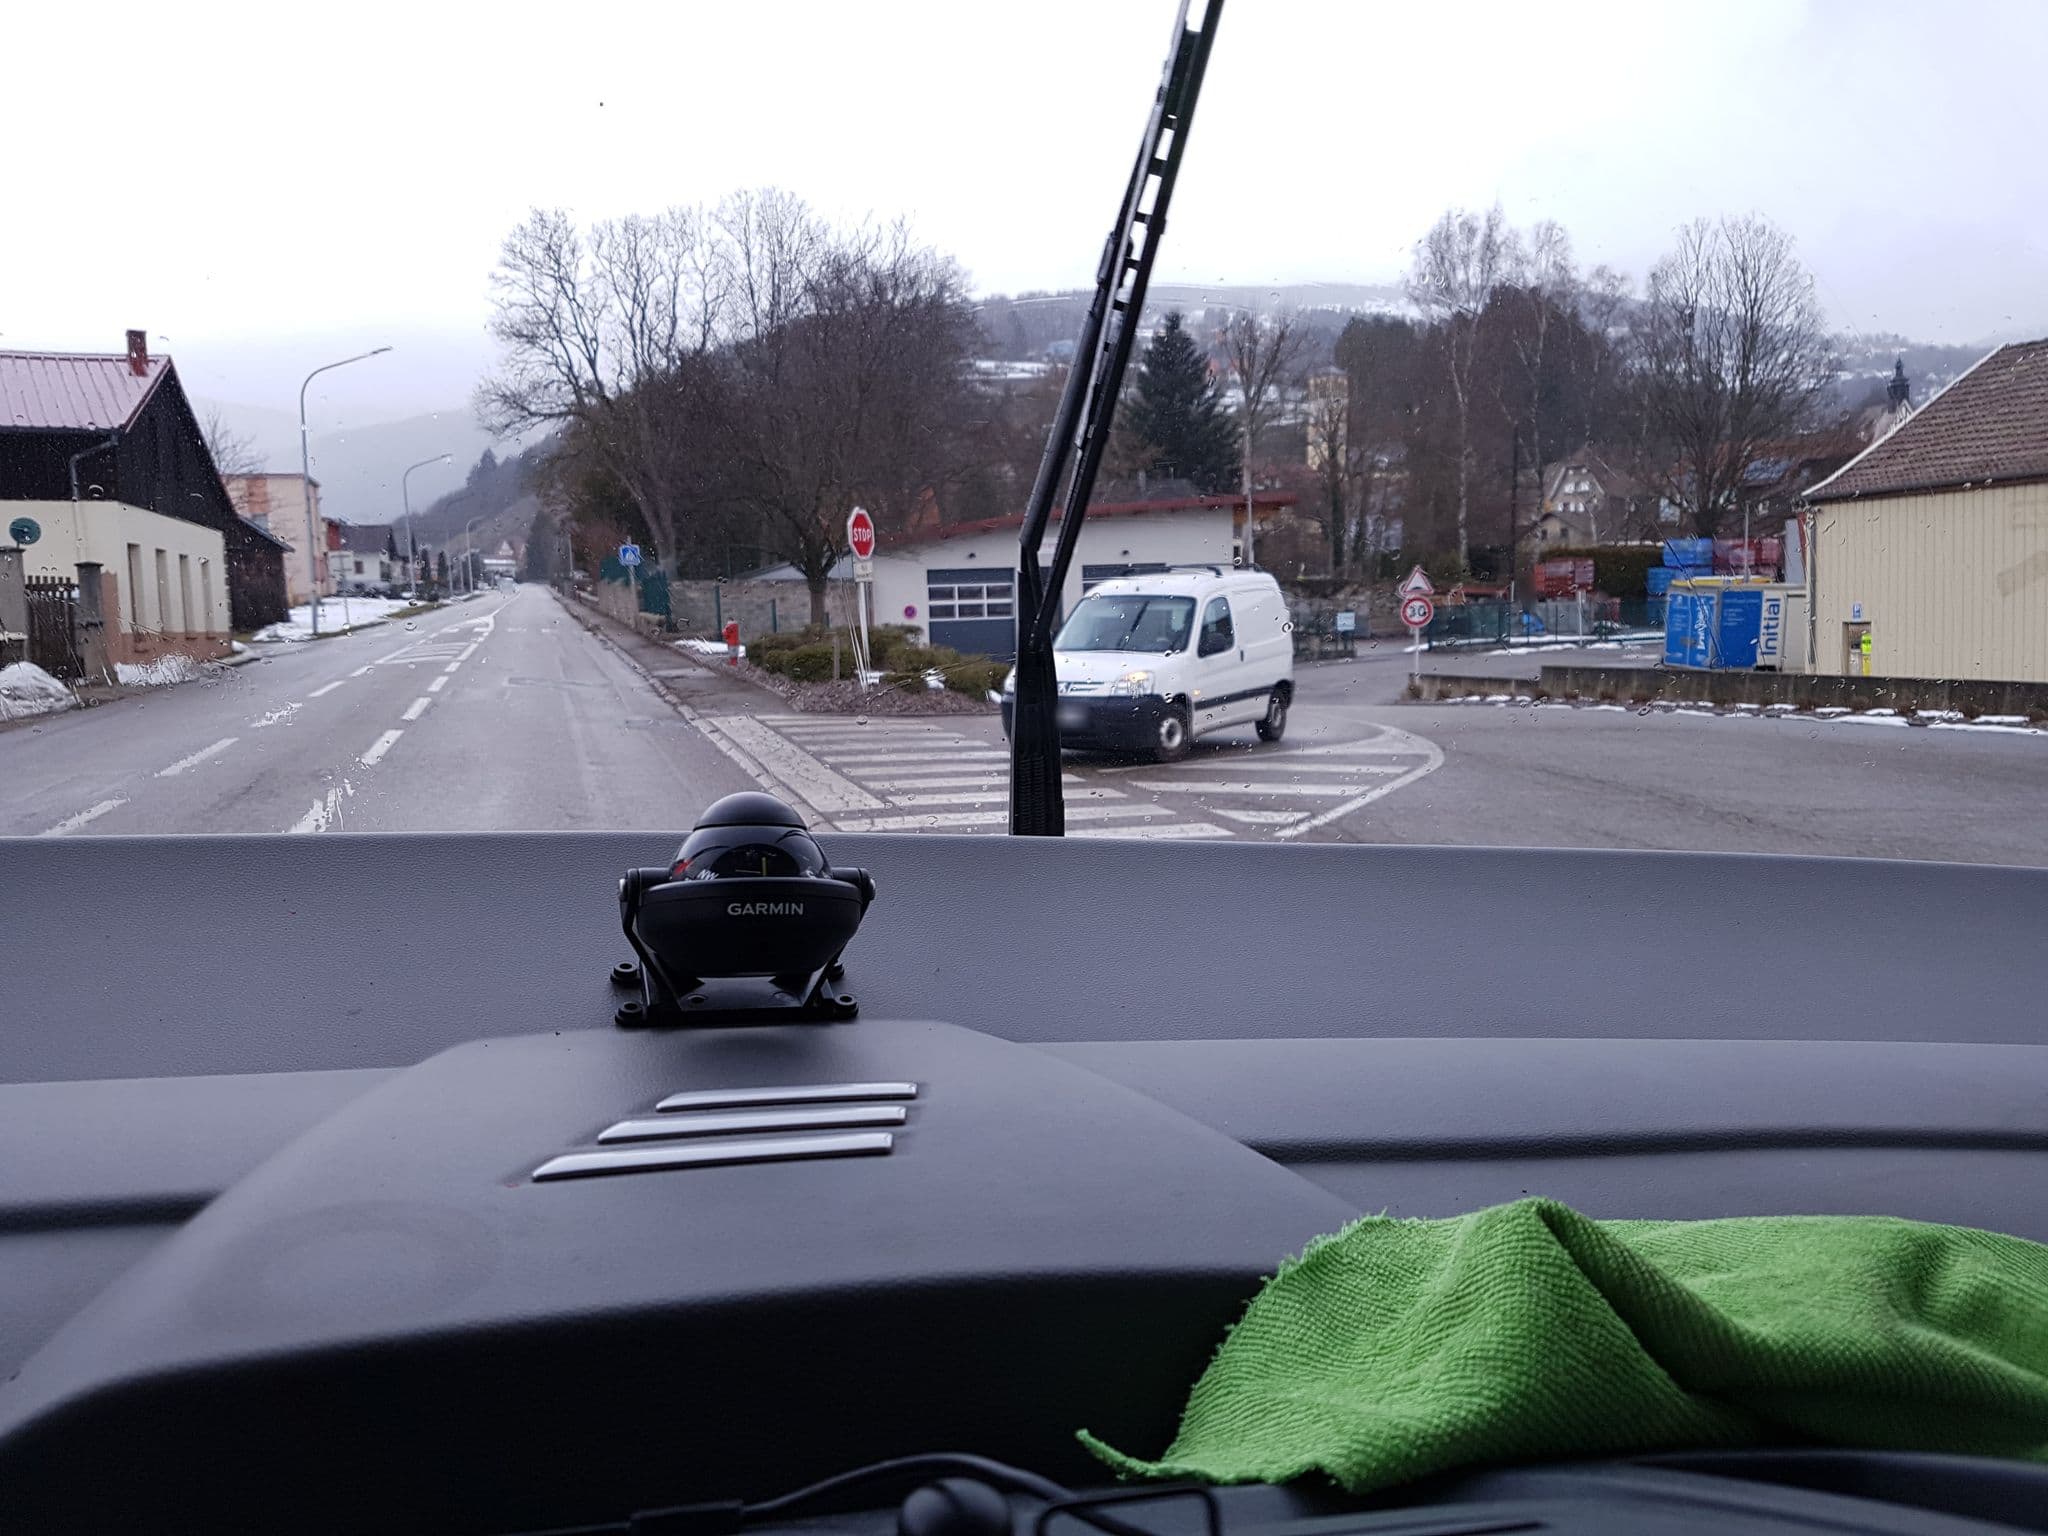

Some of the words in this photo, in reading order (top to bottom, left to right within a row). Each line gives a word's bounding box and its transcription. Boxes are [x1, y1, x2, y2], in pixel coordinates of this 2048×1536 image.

[853, 527, 872, 542] STOP
[1408, 605, 1427, 618] 30
[1761, 598, 1781, 656] Initial
[727, 903, 804, 915] GARMIN
